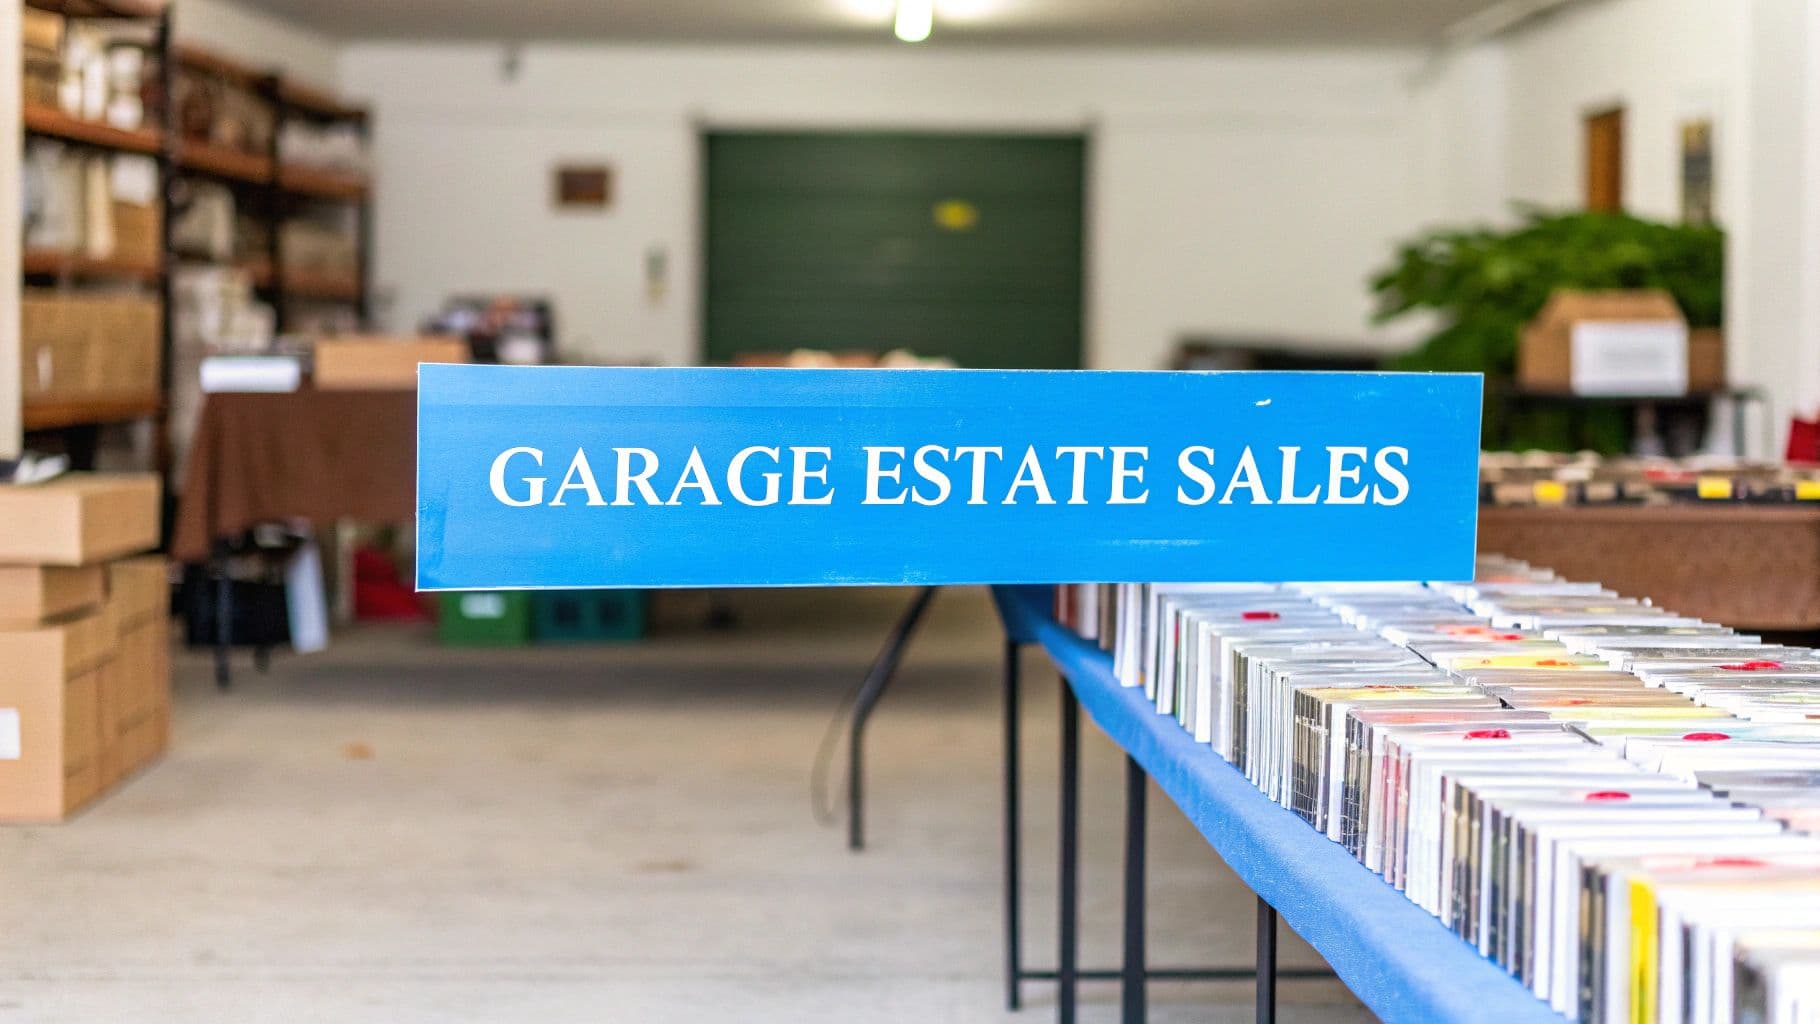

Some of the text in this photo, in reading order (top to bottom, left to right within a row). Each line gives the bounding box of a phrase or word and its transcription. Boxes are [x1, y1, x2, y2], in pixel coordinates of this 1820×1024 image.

[489, 444, 1410, 507] GARAGE ESTATE SALES
